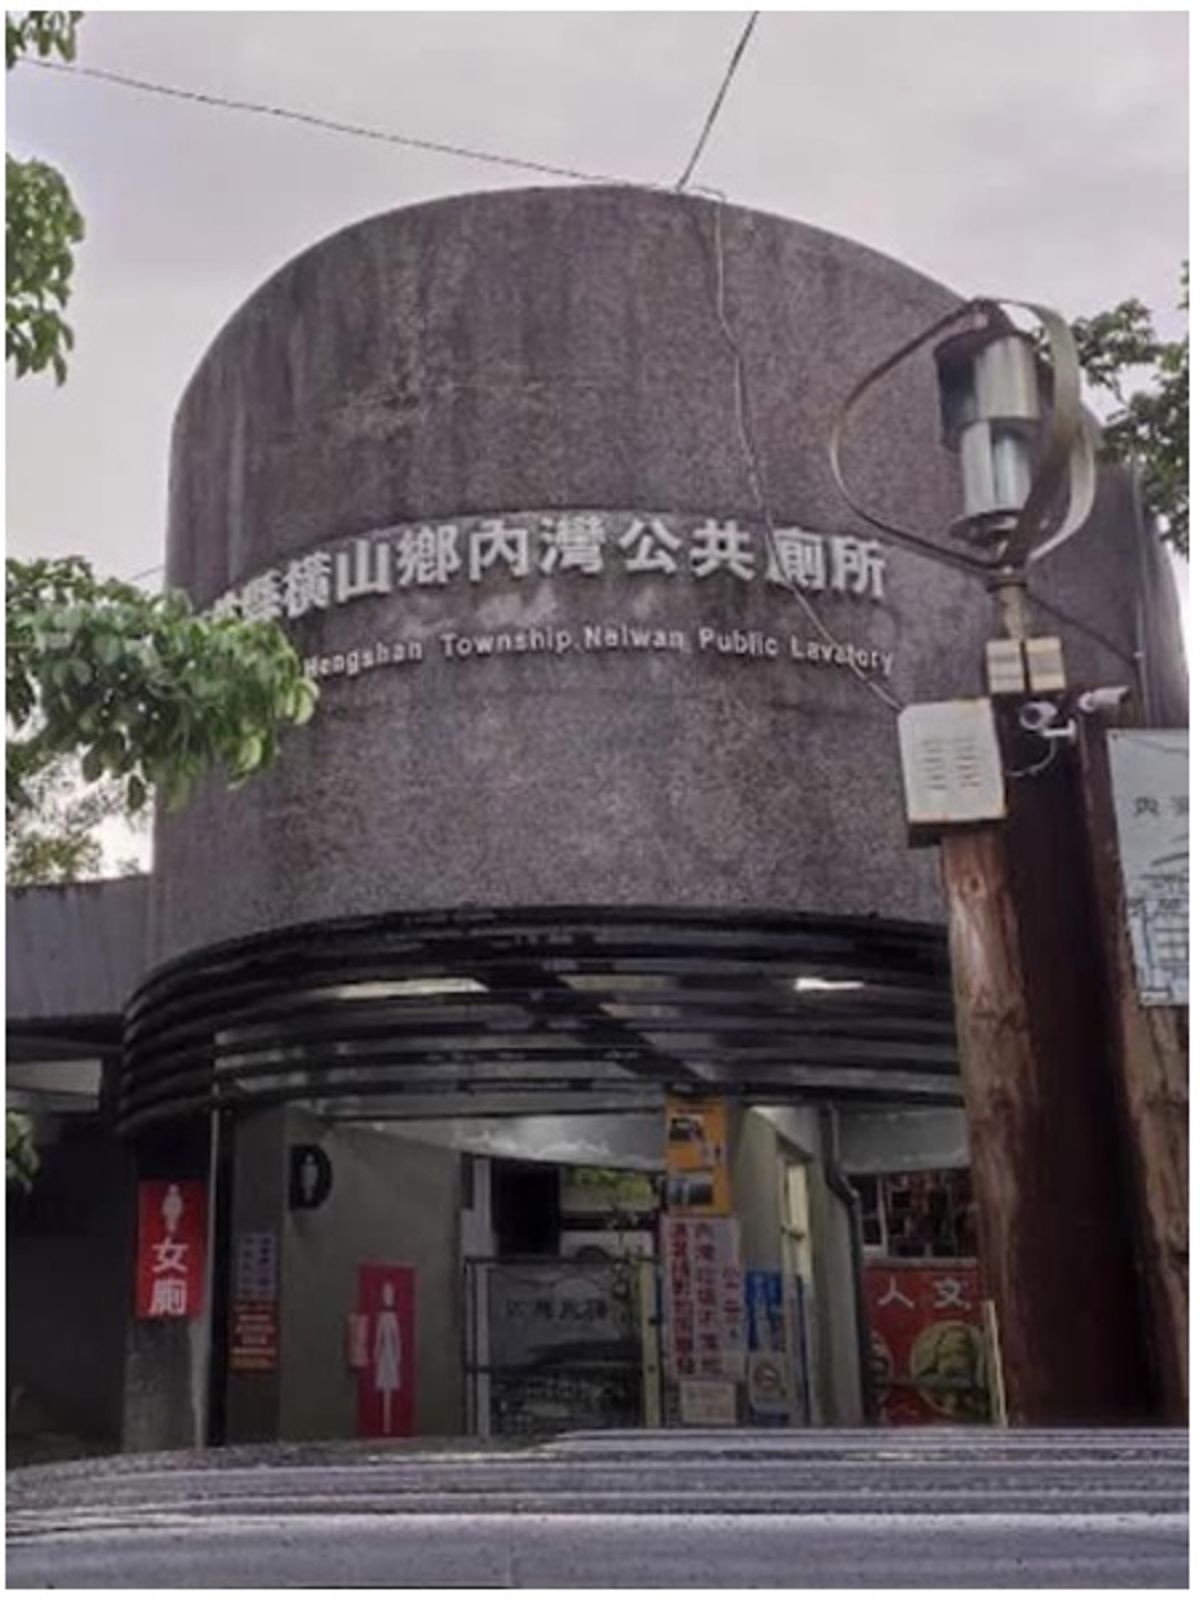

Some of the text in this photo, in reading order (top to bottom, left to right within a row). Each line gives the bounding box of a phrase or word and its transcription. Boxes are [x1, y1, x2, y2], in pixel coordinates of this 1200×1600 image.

[304, 641, 424, 678] Hengshan
[699, 626, 778, 656] Public
[791, 636, 895, 677] Lavatory
[150, 1241, 189, 1315] 女廁
